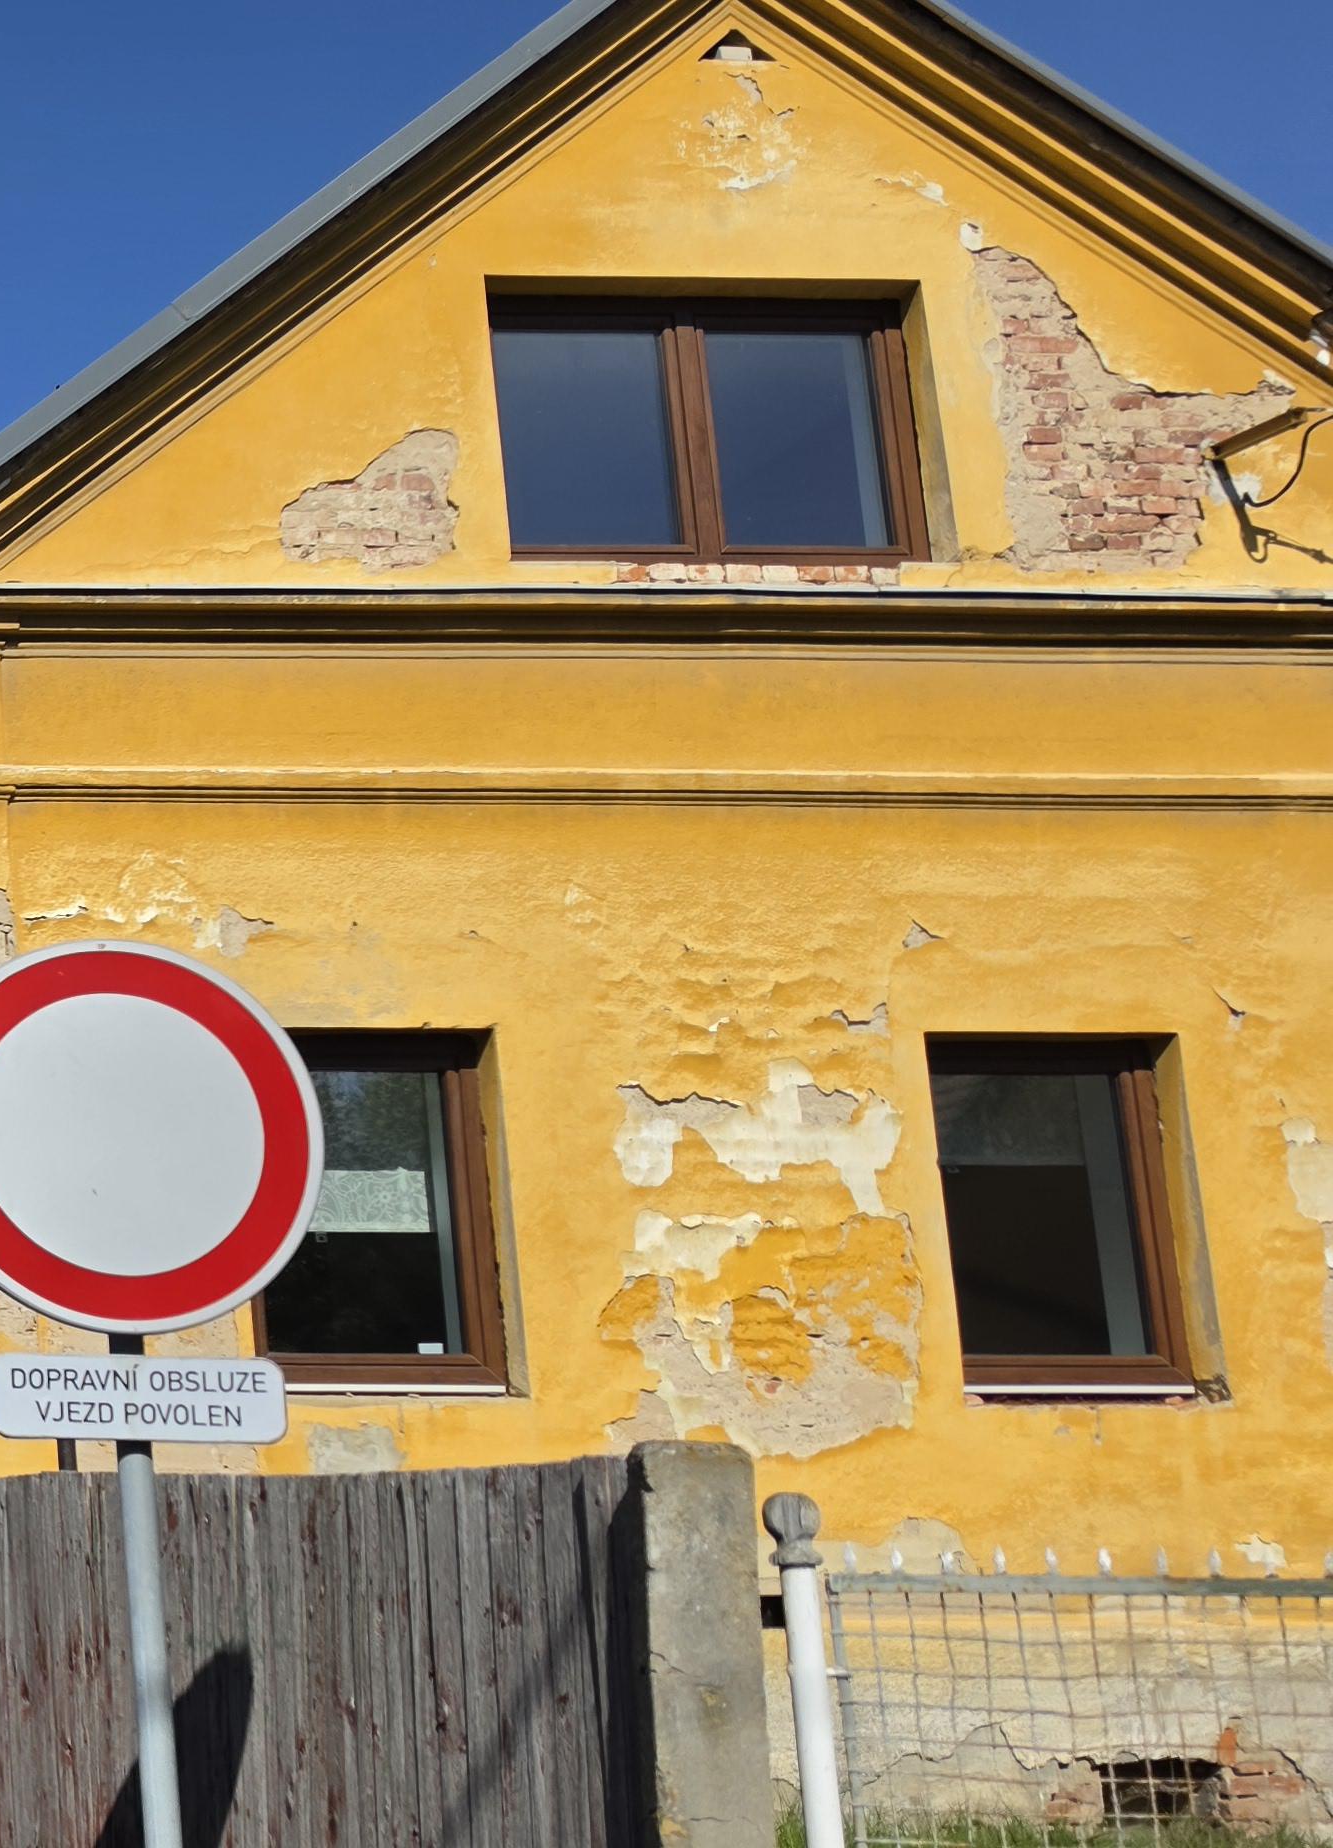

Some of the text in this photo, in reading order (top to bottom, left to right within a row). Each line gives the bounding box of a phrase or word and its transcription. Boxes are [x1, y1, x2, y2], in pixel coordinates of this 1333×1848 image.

[11, 1364, 268, 1393] DOPRAVNÍ OBSLUZE
[35, 1400, 242, 1427] VJEZD POVOLEN
